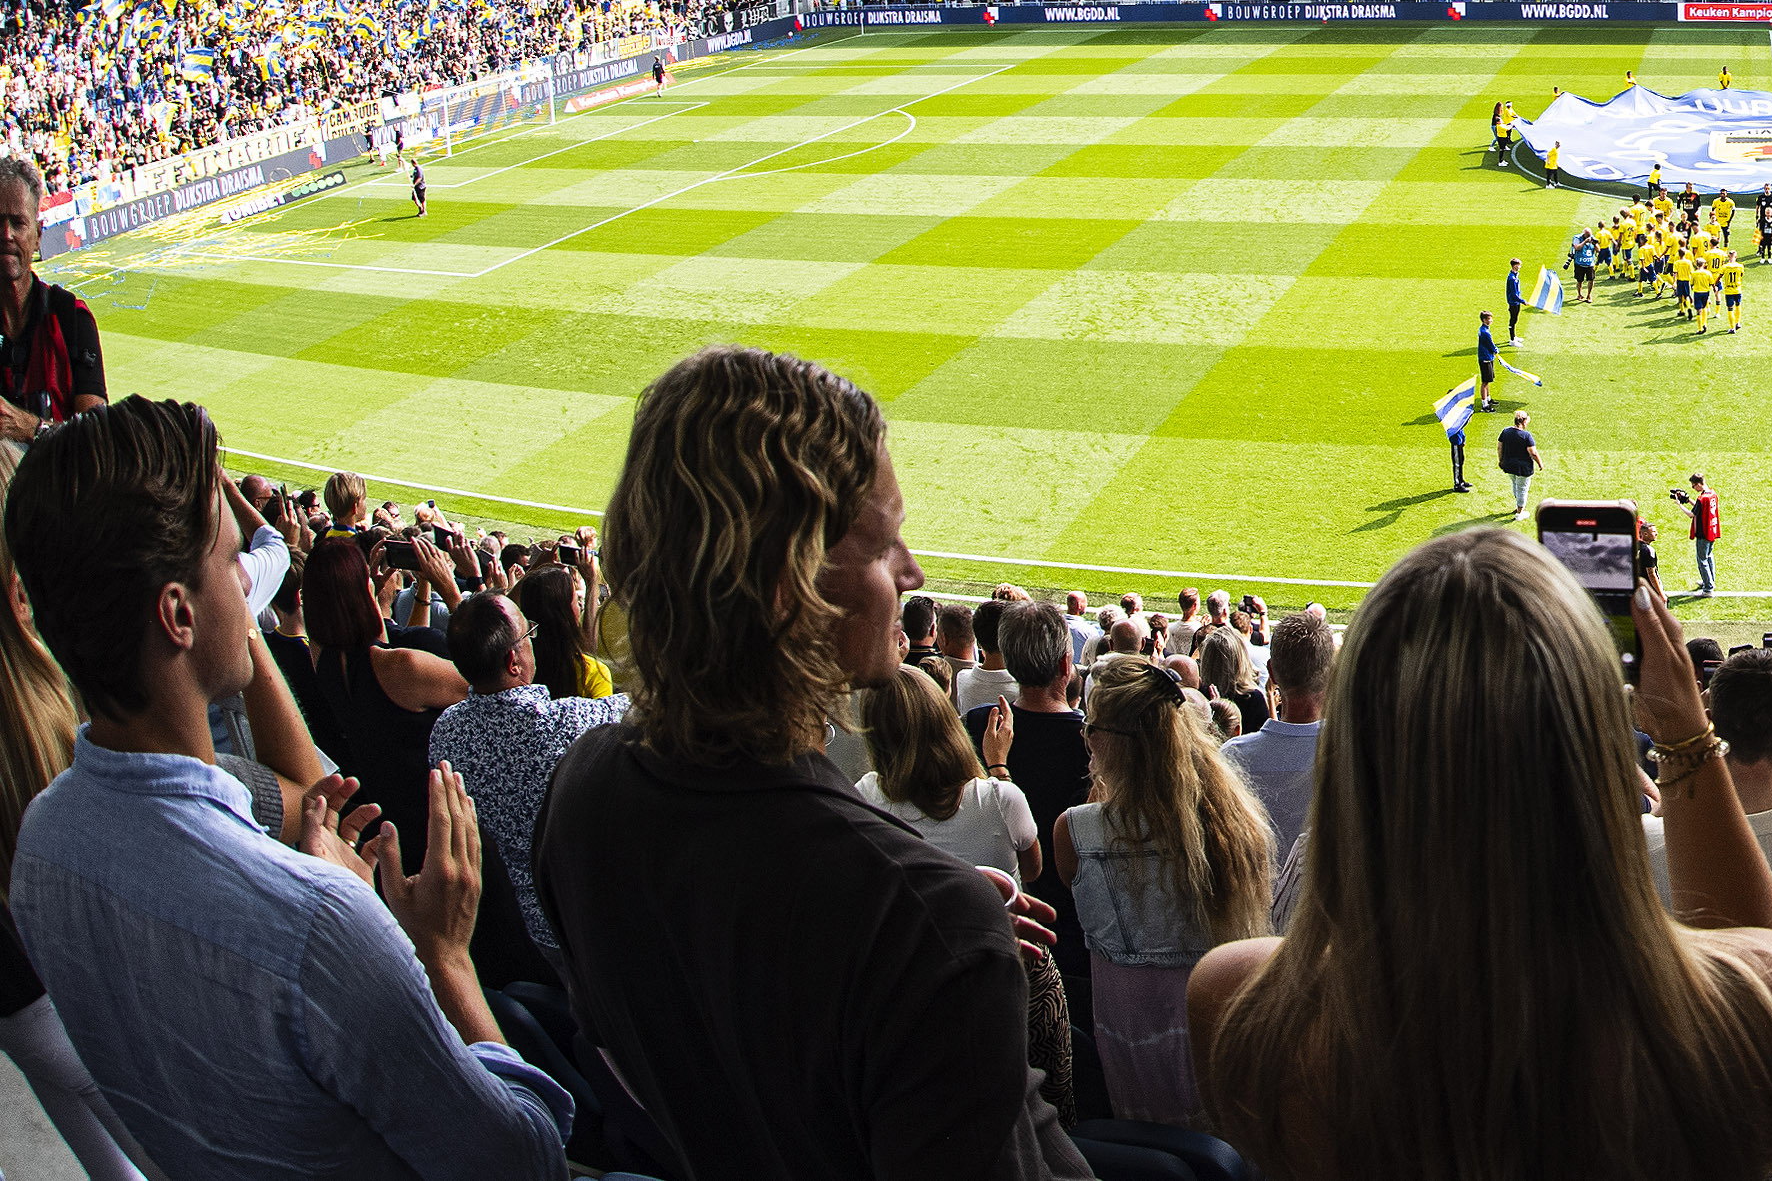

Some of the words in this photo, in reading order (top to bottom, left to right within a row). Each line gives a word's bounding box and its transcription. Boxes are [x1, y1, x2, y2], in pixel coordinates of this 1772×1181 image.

[868, 11, 903, 24] DIJKSTRA
[905, 10, 941, 23] DRAISMA
[1045, 6, 1120, 21] WWW.BGDD.NL
[1227, 5, 1301, 19] BOUWGROEP
[1305, 4, 1349, 19] DIJKSTRA
[1351, 4, 1396, 19] DRAISMA
[1521, 4, 1609, 18] WWW.BGDD.NL
[1689, 7, 1730, 17] Keuken
[580, 63, 609, 87] DIJKSTRA
[609, 59, 638, 81] DRAISMA
[91, 200, 171, 239] BOUWGROEP
[174, 180, 221, 211] DIJKSTRA
[220, 165, 265, 197] DRAISMA
[1712, 257, 1720, 269] 10
[1729, 271, 1737, 283] 11
